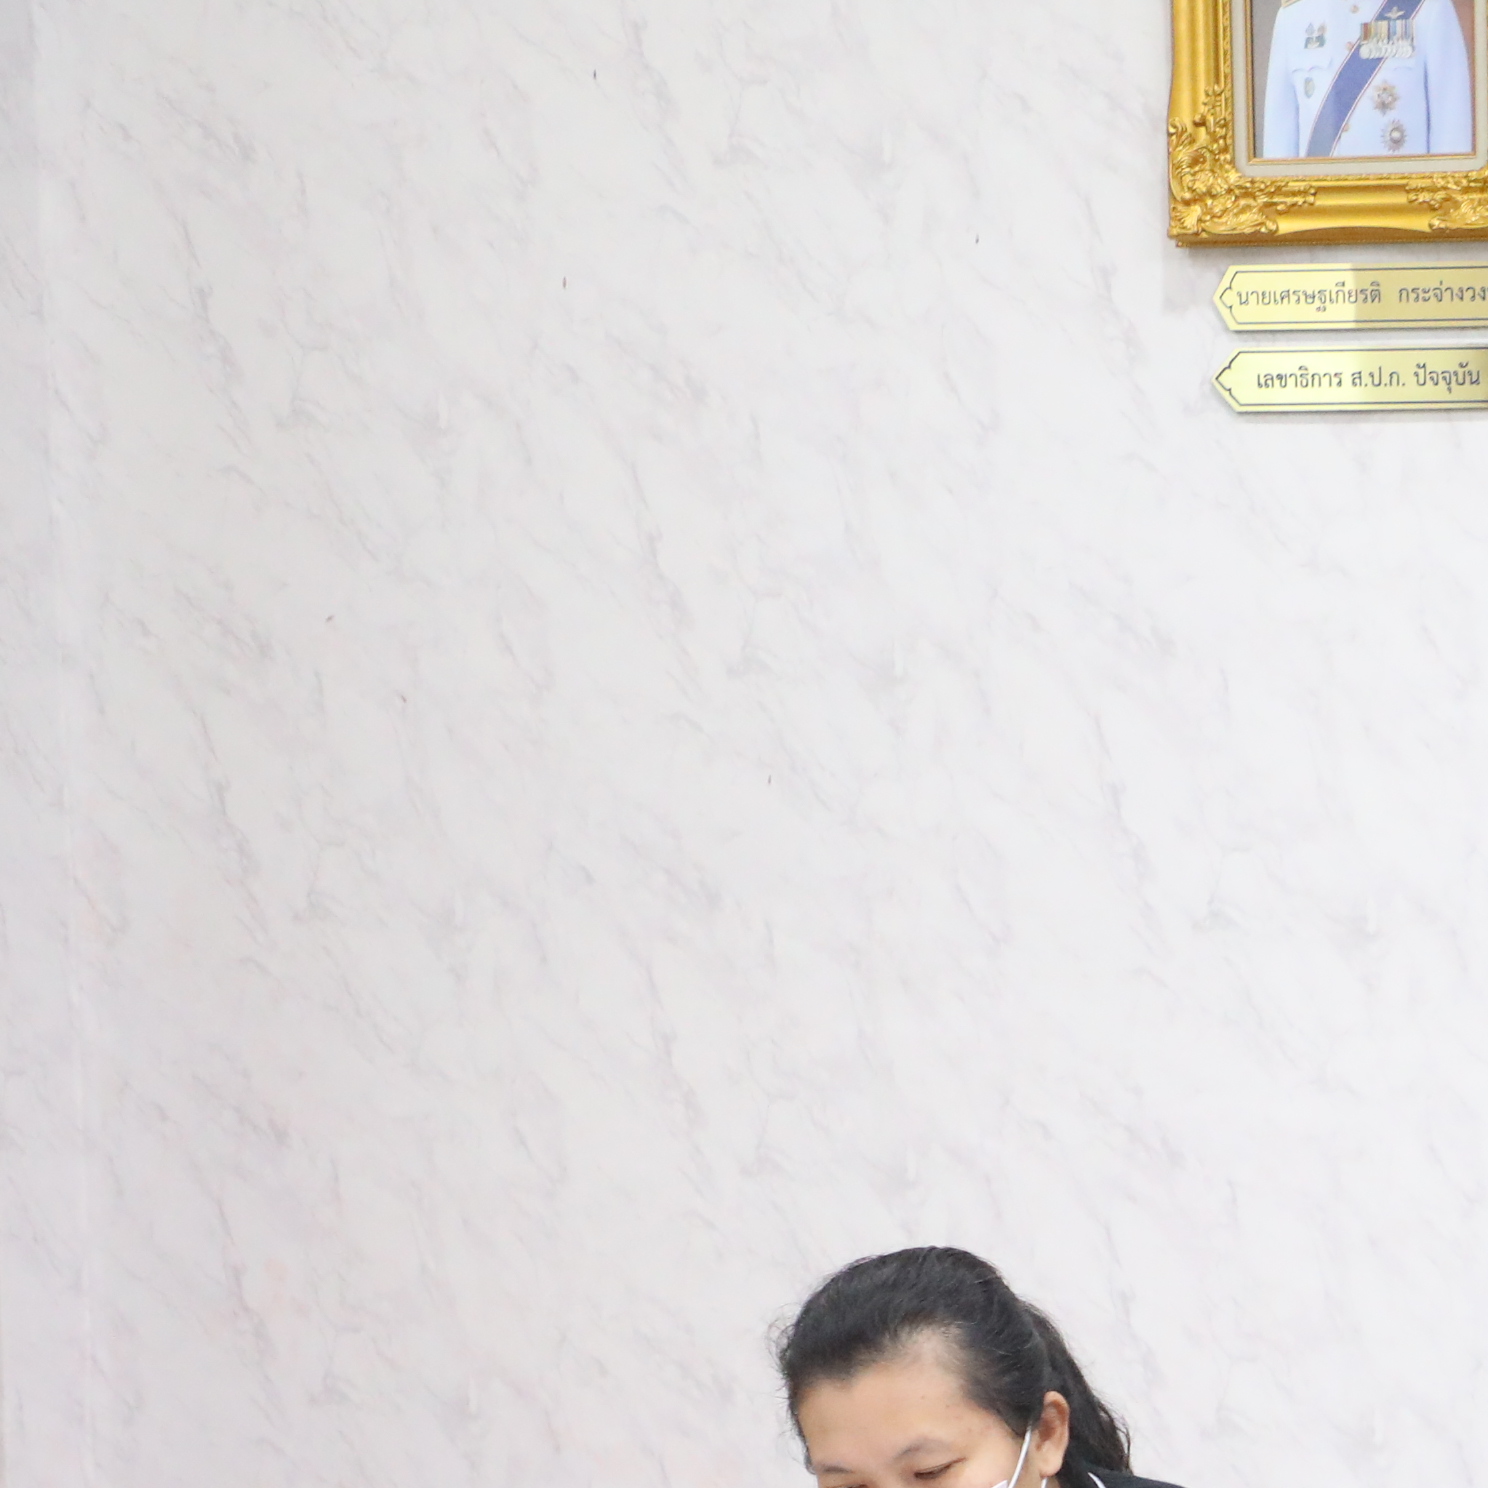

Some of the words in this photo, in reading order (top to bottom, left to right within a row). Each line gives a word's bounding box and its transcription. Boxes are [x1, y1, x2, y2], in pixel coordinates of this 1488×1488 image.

[1236, 280, 1382, 312] นายเศรษฐเกียรติ
[1256, 366, 1343, 389] เลขาธิการ
[1351, 366, 1406, 388] ส.ป.ก.
[1413, 362, 1481, 394] ปัจจุบัน
